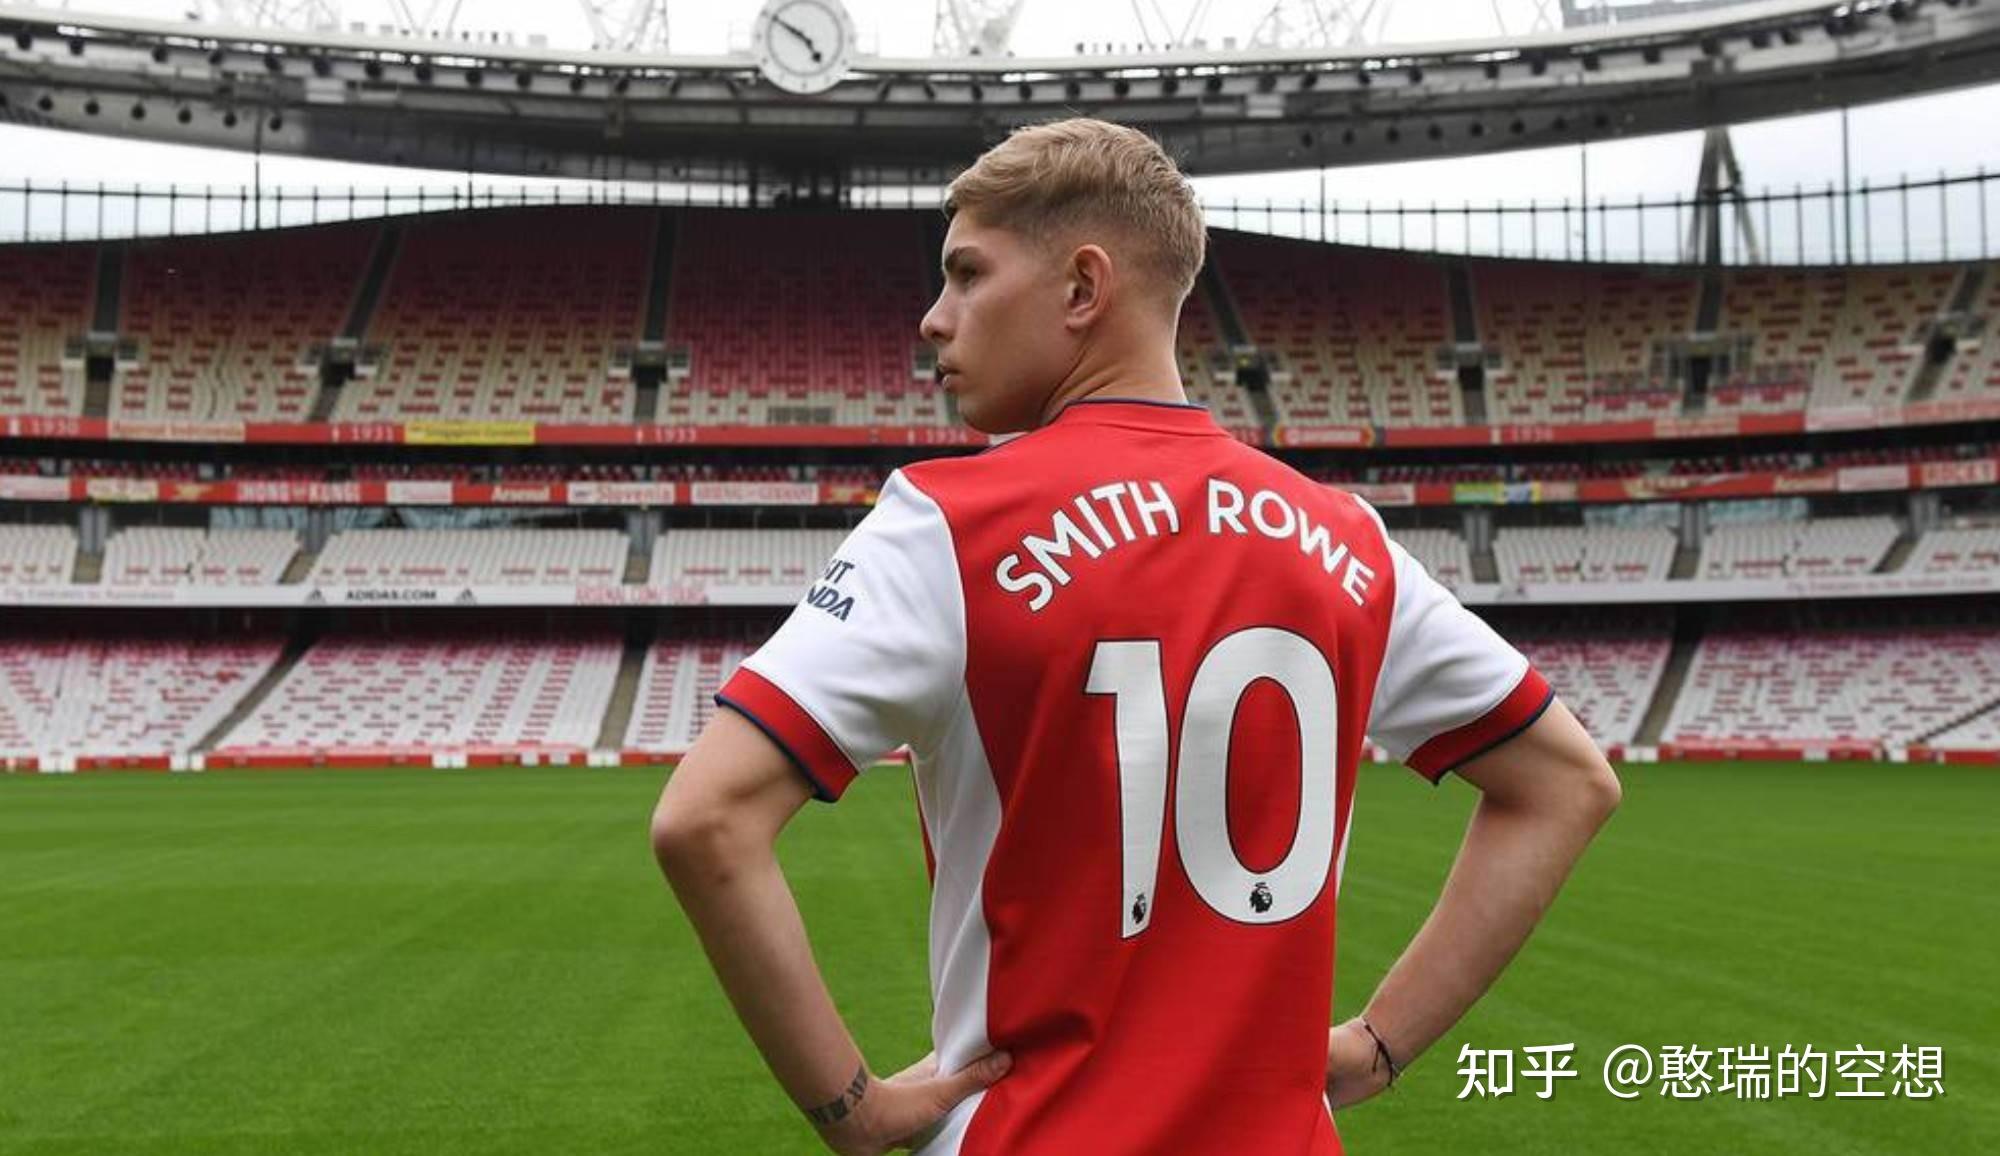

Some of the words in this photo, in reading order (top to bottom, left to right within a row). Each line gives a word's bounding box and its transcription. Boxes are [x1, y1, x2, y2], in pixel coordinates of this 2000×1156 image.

[995, 481, 1180, 612] SMITH
[1207, 478, 1376, 606] ROWE
[1085, 626, 1338, 938] 10
